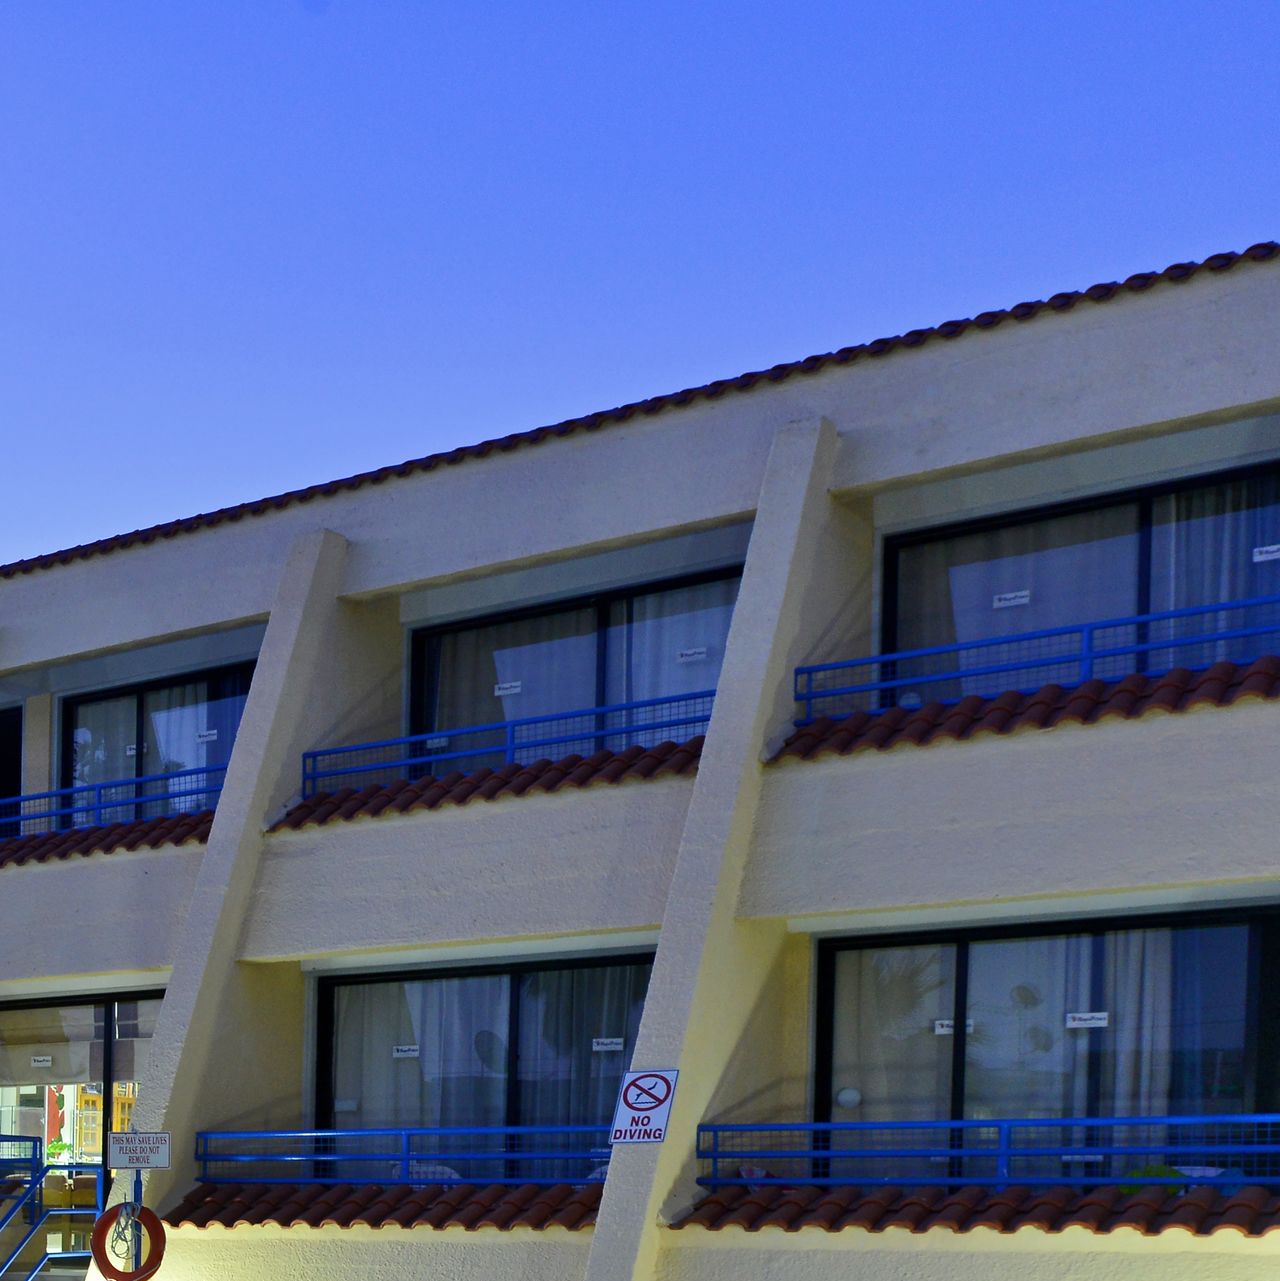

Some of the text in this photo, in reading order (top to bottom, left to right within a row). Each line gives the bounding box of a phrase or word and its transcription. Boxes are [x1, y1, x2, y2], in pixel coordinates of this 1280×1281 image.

[630, 1115, 651, 1127] NO
[613, 1128, 663, 1140] DIVING
[118, 1146, 160, 1154] PLEASE DO NOT
